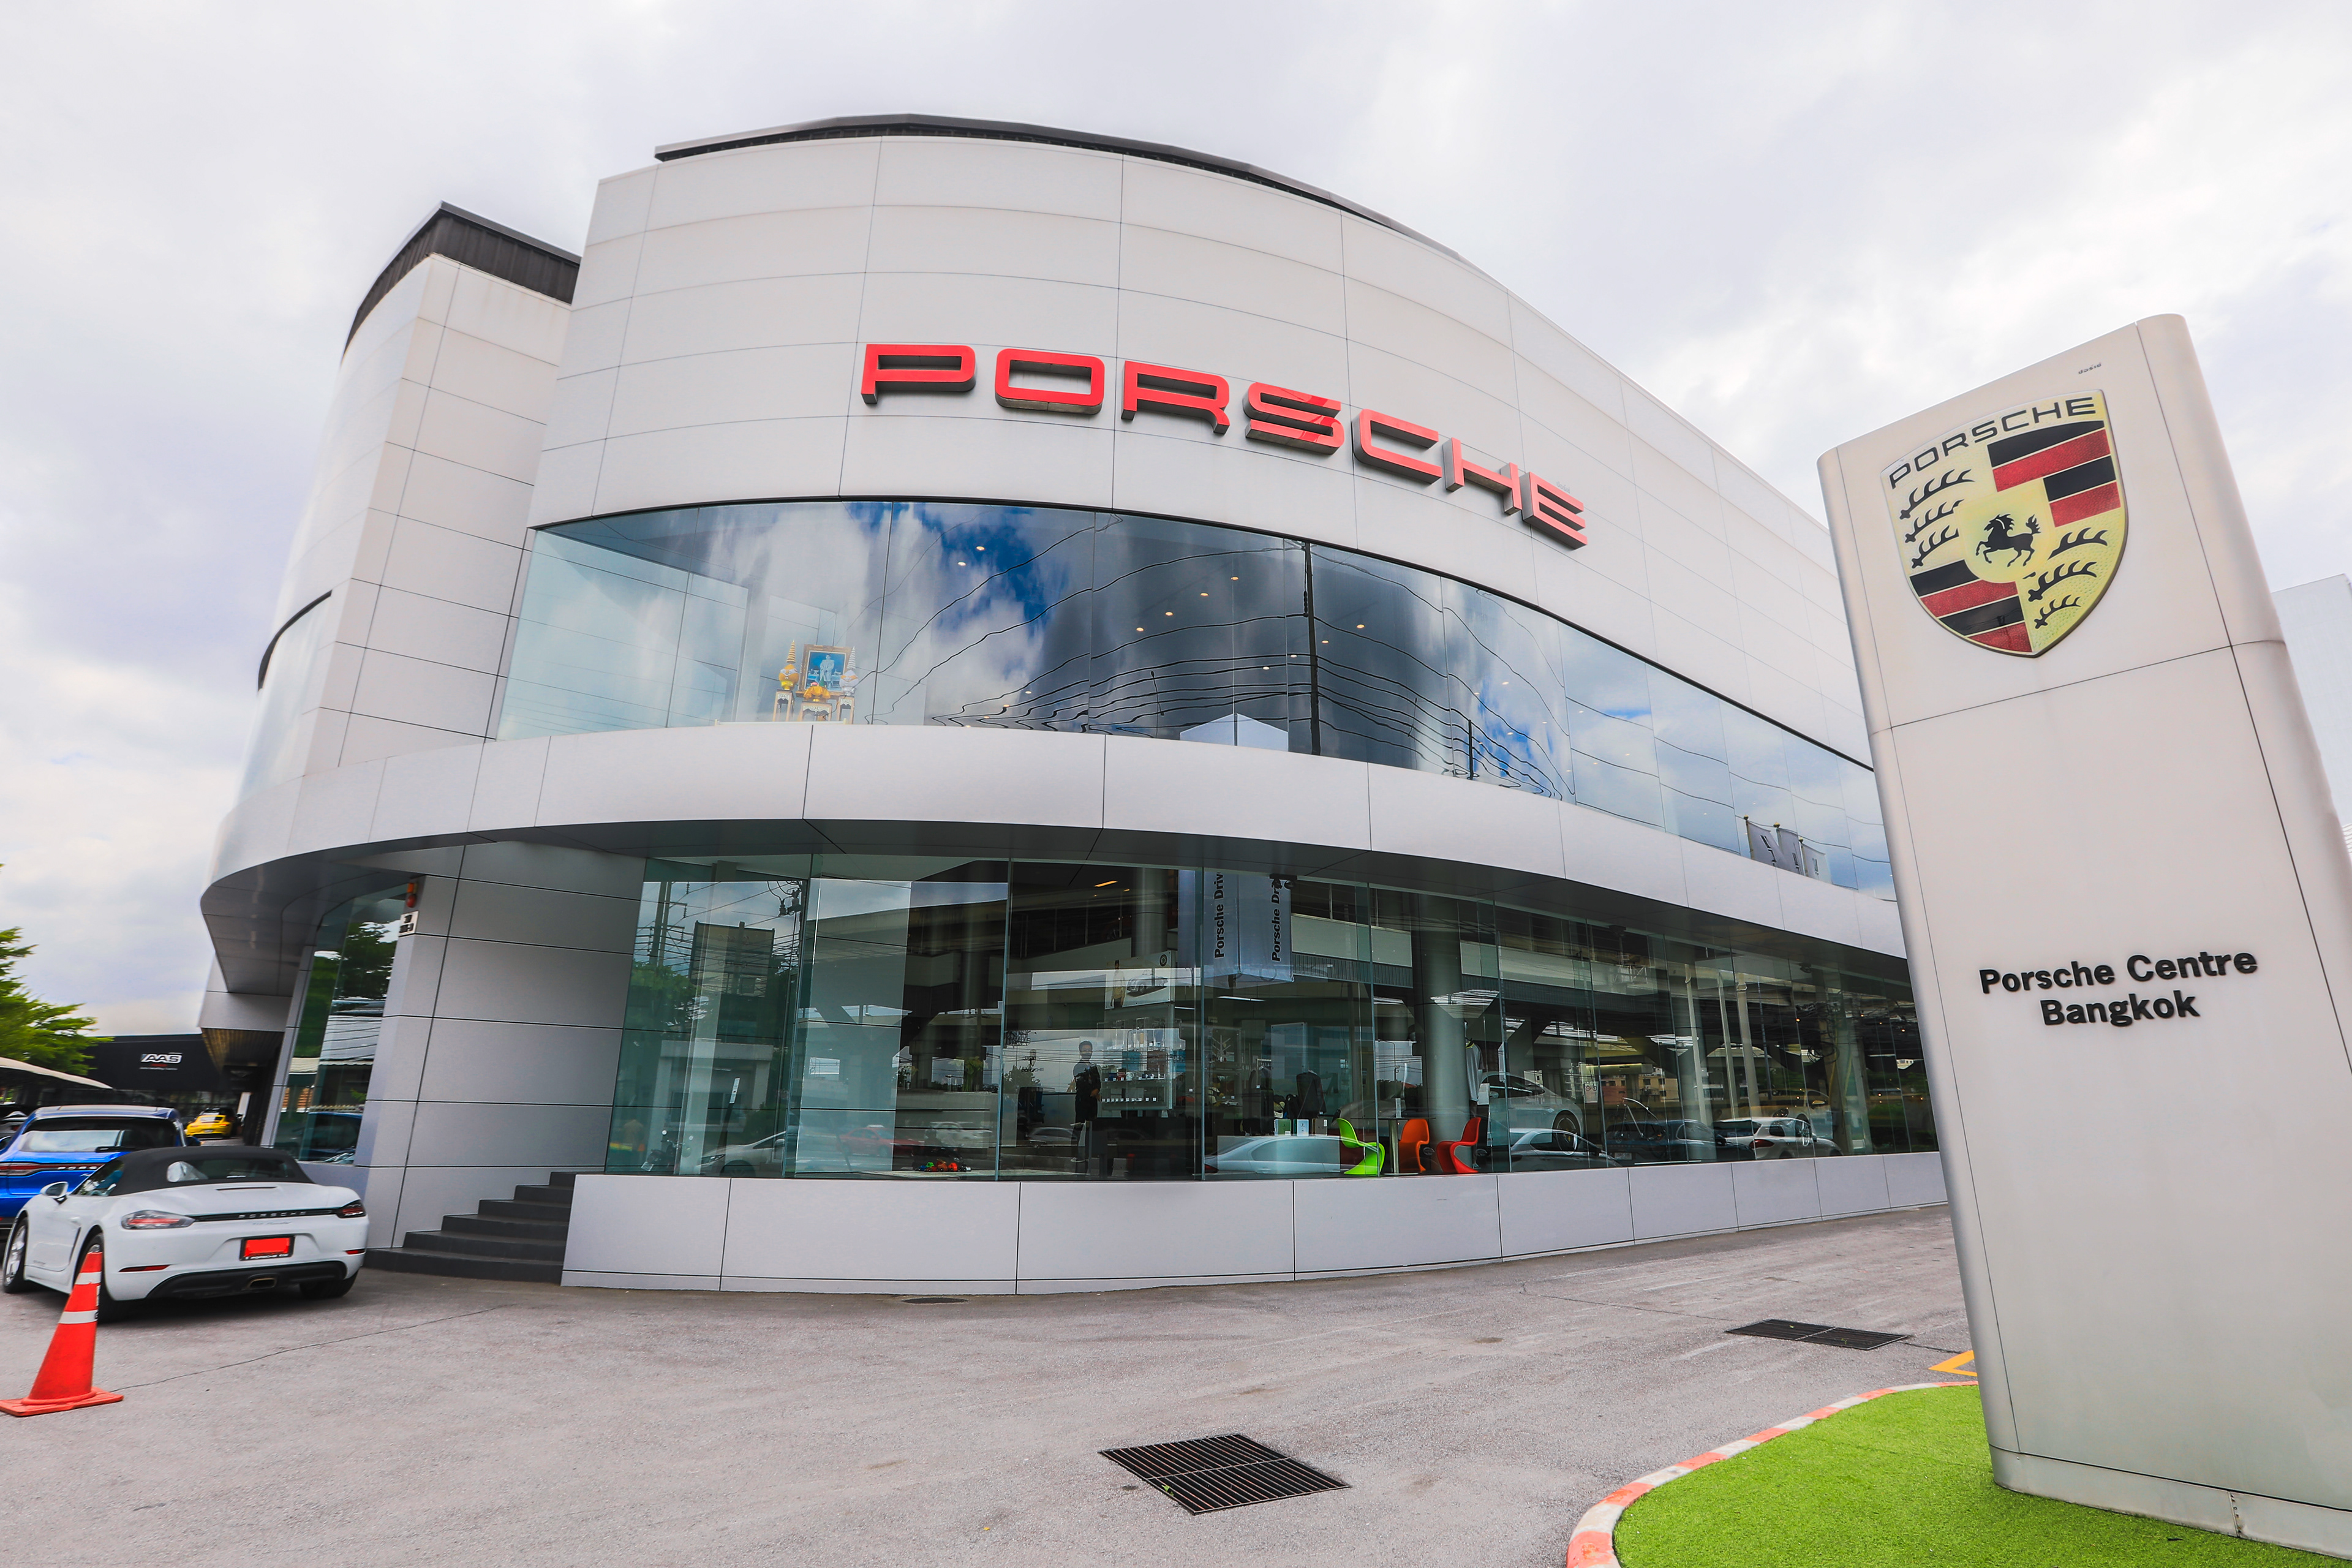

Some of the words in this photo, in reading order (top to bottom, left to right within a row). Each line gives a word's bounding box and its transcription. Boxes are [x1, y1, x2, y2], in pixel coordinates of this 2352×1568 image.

[861, 343, 1588, 549] PORSCHE
[1888, 396, 2097, 489] PORSCHE
[1214, 904, 1224, 959] Porsche
[1272, 908, 1281, 962] Porsche
[1980, 961, 2115, 994] Porsche
[2127, 951, 2258, 982] Centre
[2040, 989, 2201, 1027] Bangkok
